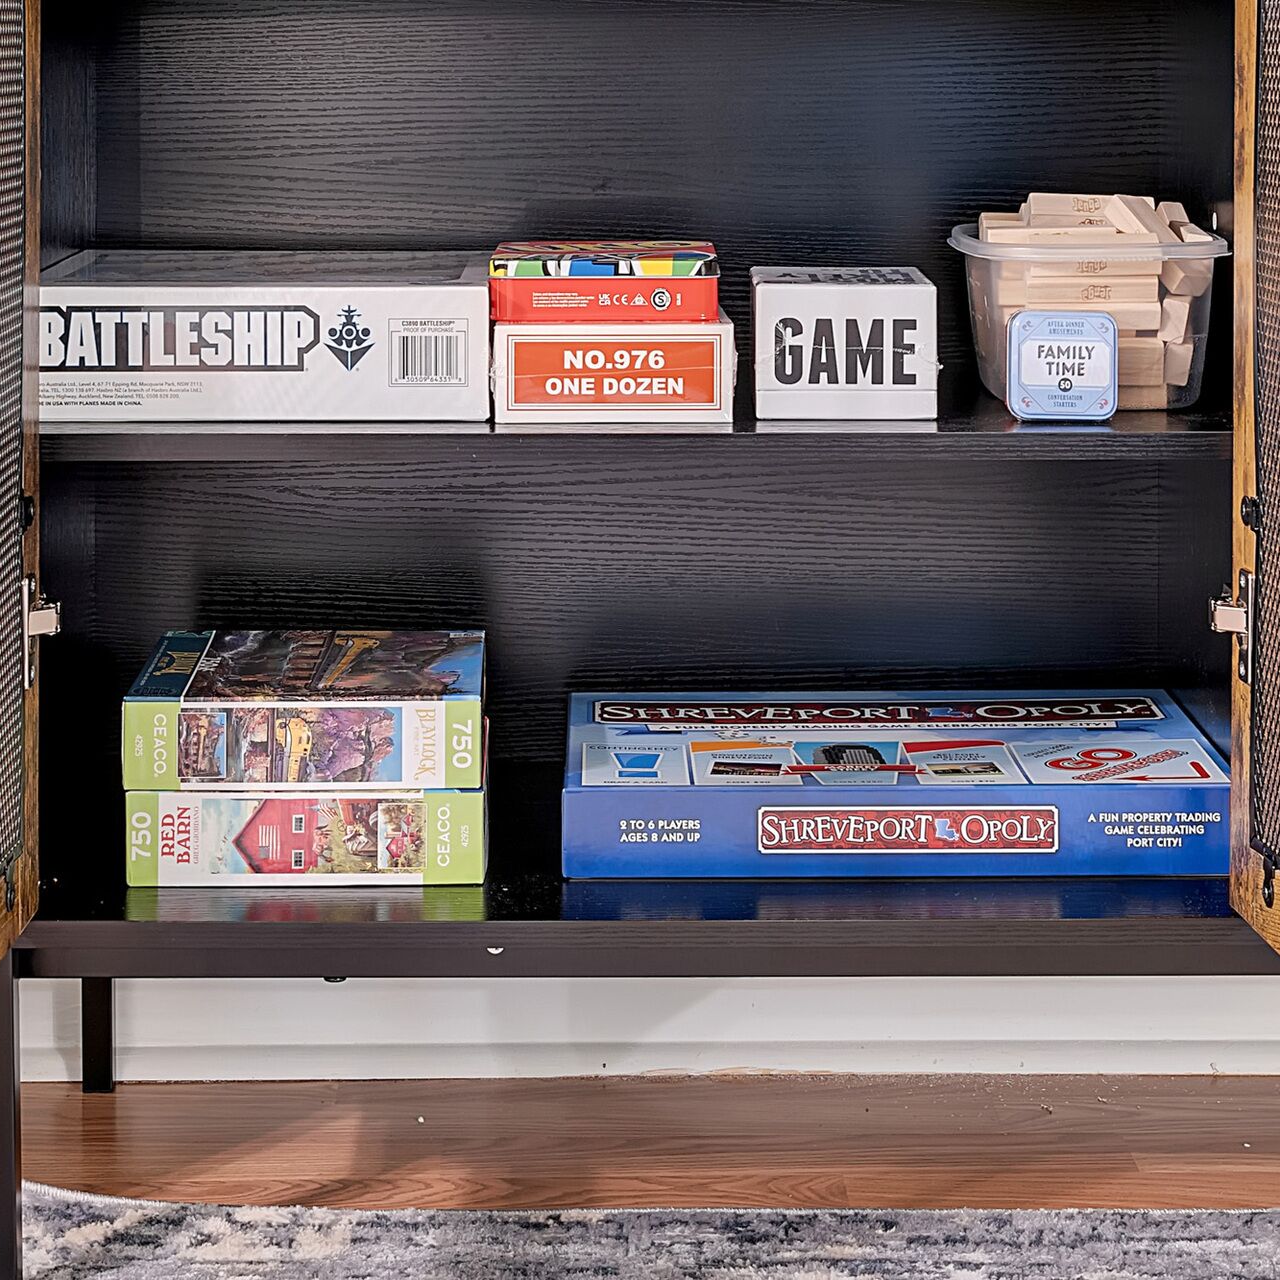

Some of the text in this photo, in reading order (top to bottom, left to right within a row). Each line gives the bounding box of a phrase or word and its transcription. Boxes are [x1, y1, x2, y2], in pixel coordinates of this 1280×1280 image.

[39, 311, 315, 367] BATTLESHIP
[563, 350, 665, 370] NO.976
[775, 317, 917, 385] GAME
[1037, 345, 1095, 360] FAMILY
[1045, 362, 1085, 377] TIME
[545, 377, 684, 395] ONE DOZEN
[1059, 381, 1071, 389] 50
[602, 705, 920, 720] SHREVEPORT
[452, 719, 472, 769] 750
[1045, 748, 1137, 770] GO
[620, 820, 701, 830] 2 TO 6 PLAYERS
[1087, 813, 1221, 822] A FUN PROPERTY TRADING
[131, 811, 152, 861] 750
[161, 813, 175, 857] RED
[176, 806, 191, 864] BARN
[620, 833, 700, 842] AGES 8 AND UP
[762, 815, 1053, 844] SHREVEPORT OPOLY
[1104, 825, 1204, 834] GAME CELEBRATING
[1127, 838, 1182, 847] PORT CITY!
